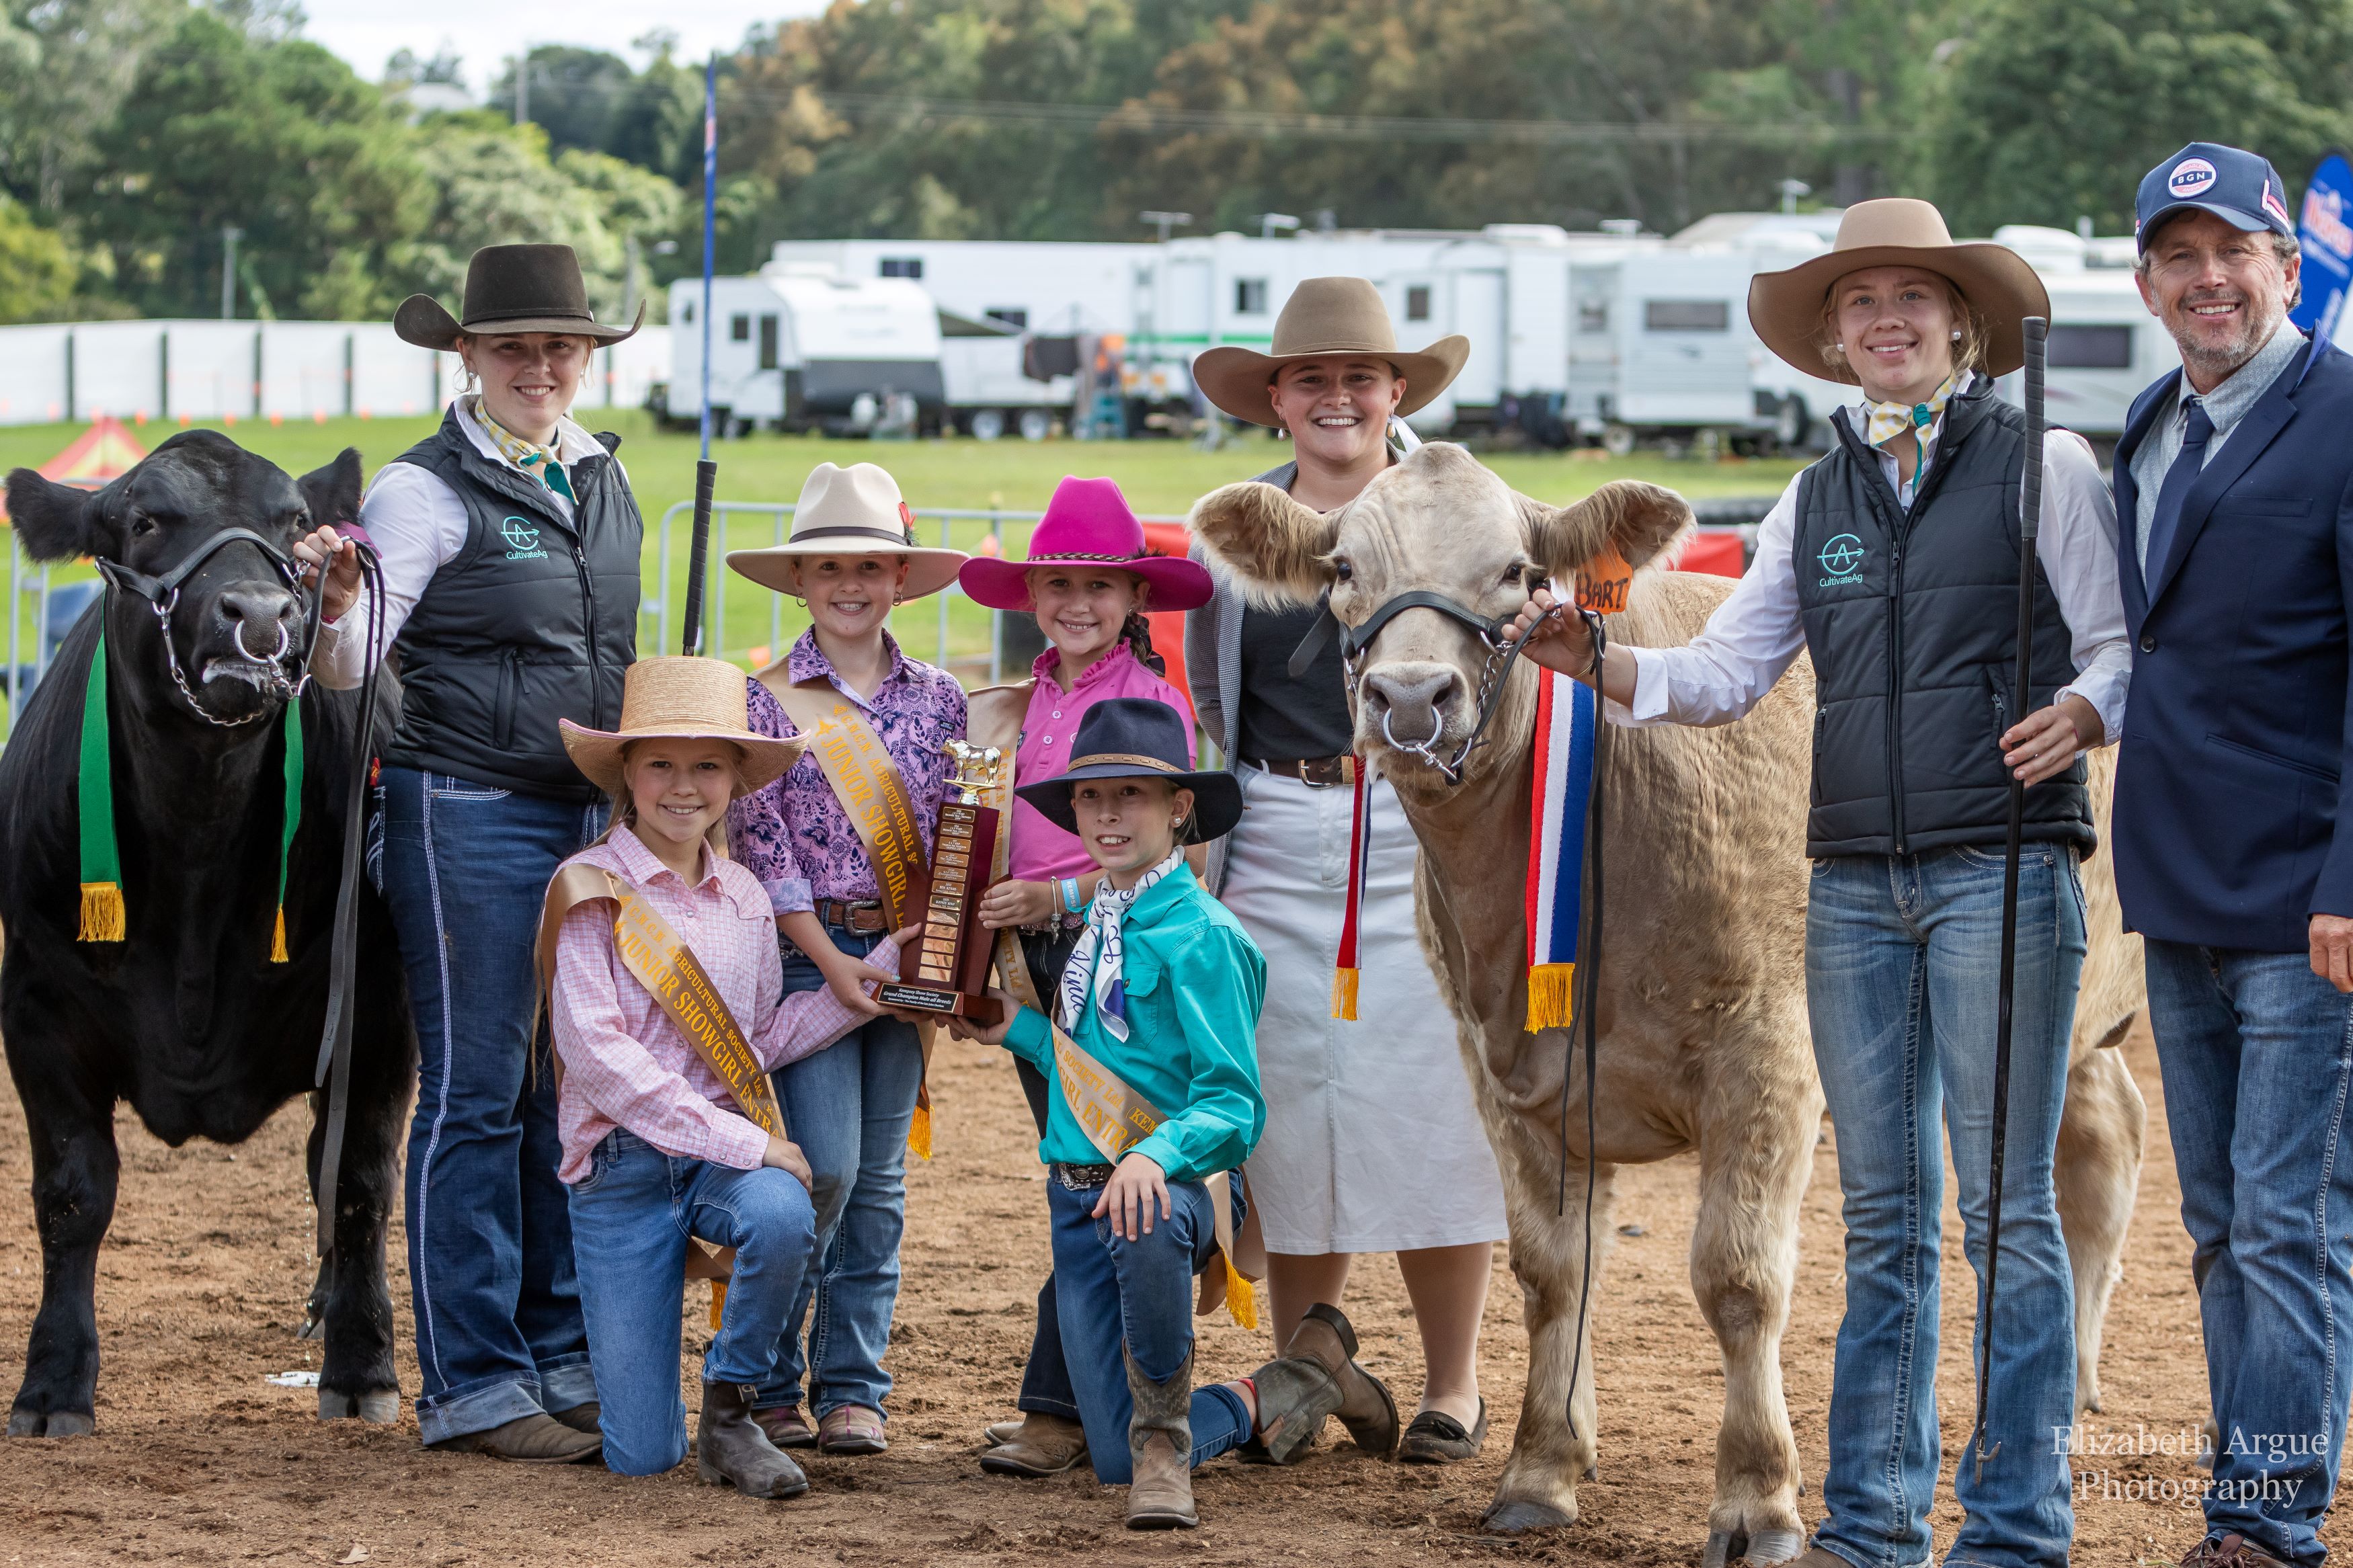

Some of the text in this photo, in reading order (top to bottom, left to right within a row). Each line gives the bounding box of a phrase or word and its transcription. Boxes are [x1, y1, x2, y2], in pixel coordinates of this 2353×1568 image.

[2178, 172, 2205, 183] BGN
[506, 550, 548, 559] CultivateAg
[1575, 571, 1628, 609] BART
[1819, 573, 1863, 587] CultivateAg
[821, 735, 907, 908] JUNIOR SHOWGIRL
[868, 757, 914, 852] AGRICULTURAL
[619, 932, 680, 998] JUNIOR
[673, 991, 742, 1089] SHOWGIRL
[897, 992, 920, 1000] Champion
[666, 945, 727, 1031] AGRICULTURAL
[726, 1029, 757, 1077] SOCIETY
[753, 1075, 763, 1100] Ltd.
[1064, 1050, 1105, 1091] SOCIETY
[1103, 1083, 1125, 1111] Ltd.
